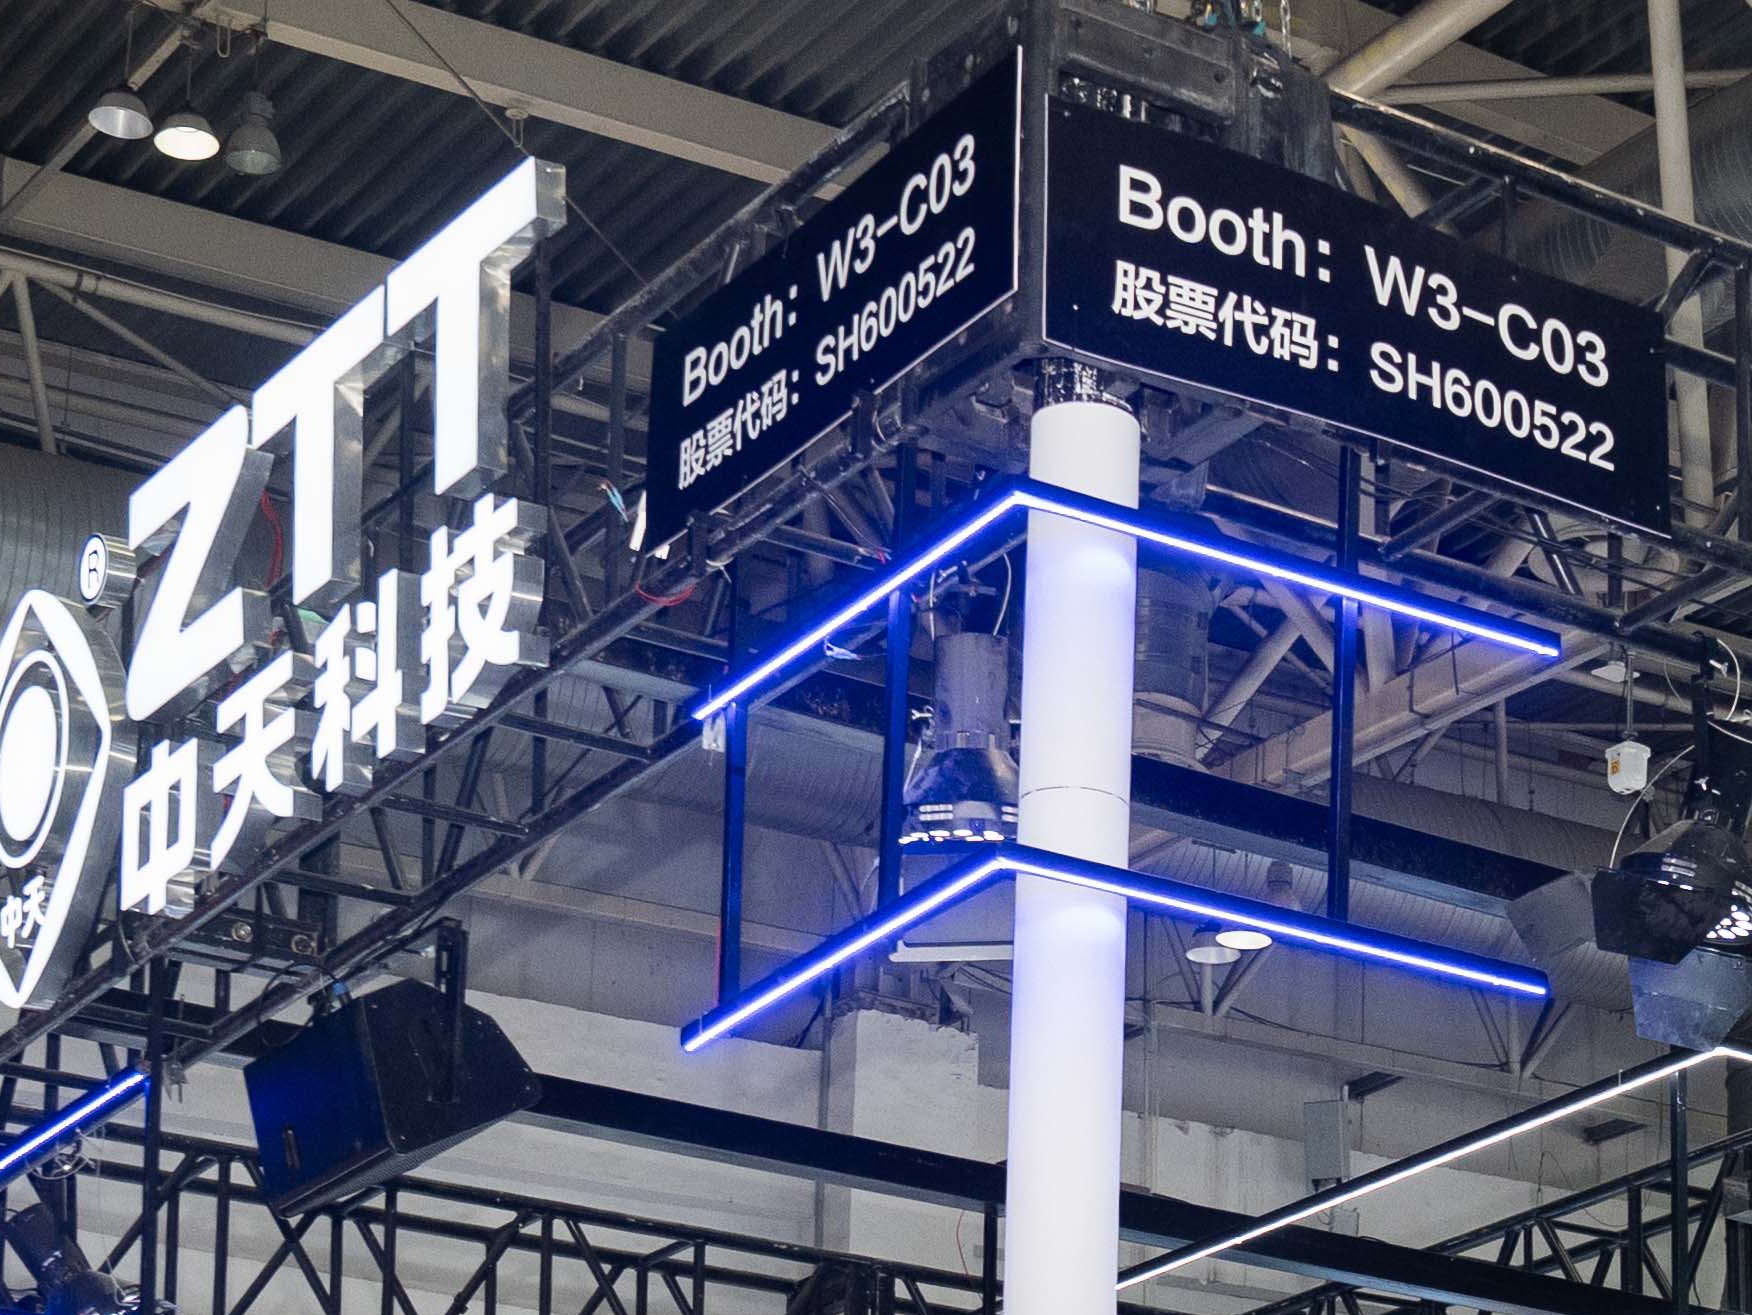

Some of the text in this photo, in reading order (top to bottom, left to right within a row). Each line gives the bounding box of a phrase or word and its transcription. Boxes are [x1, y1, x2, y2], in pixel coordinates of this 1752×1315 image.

[677, 227, 977, 493] 股票代码： SH600522
[681, 133, 978, 406] Booth: W3-C03
[1112, 261, 1615, 471] 股票代码： SH600522
[1118, 163, 1609, 388] Booth: W3-C03
[127, 156, 538, 721] ZTT
[120, 493, 521, 916] 中天科技
[0, 874, 48, 949] 中天
